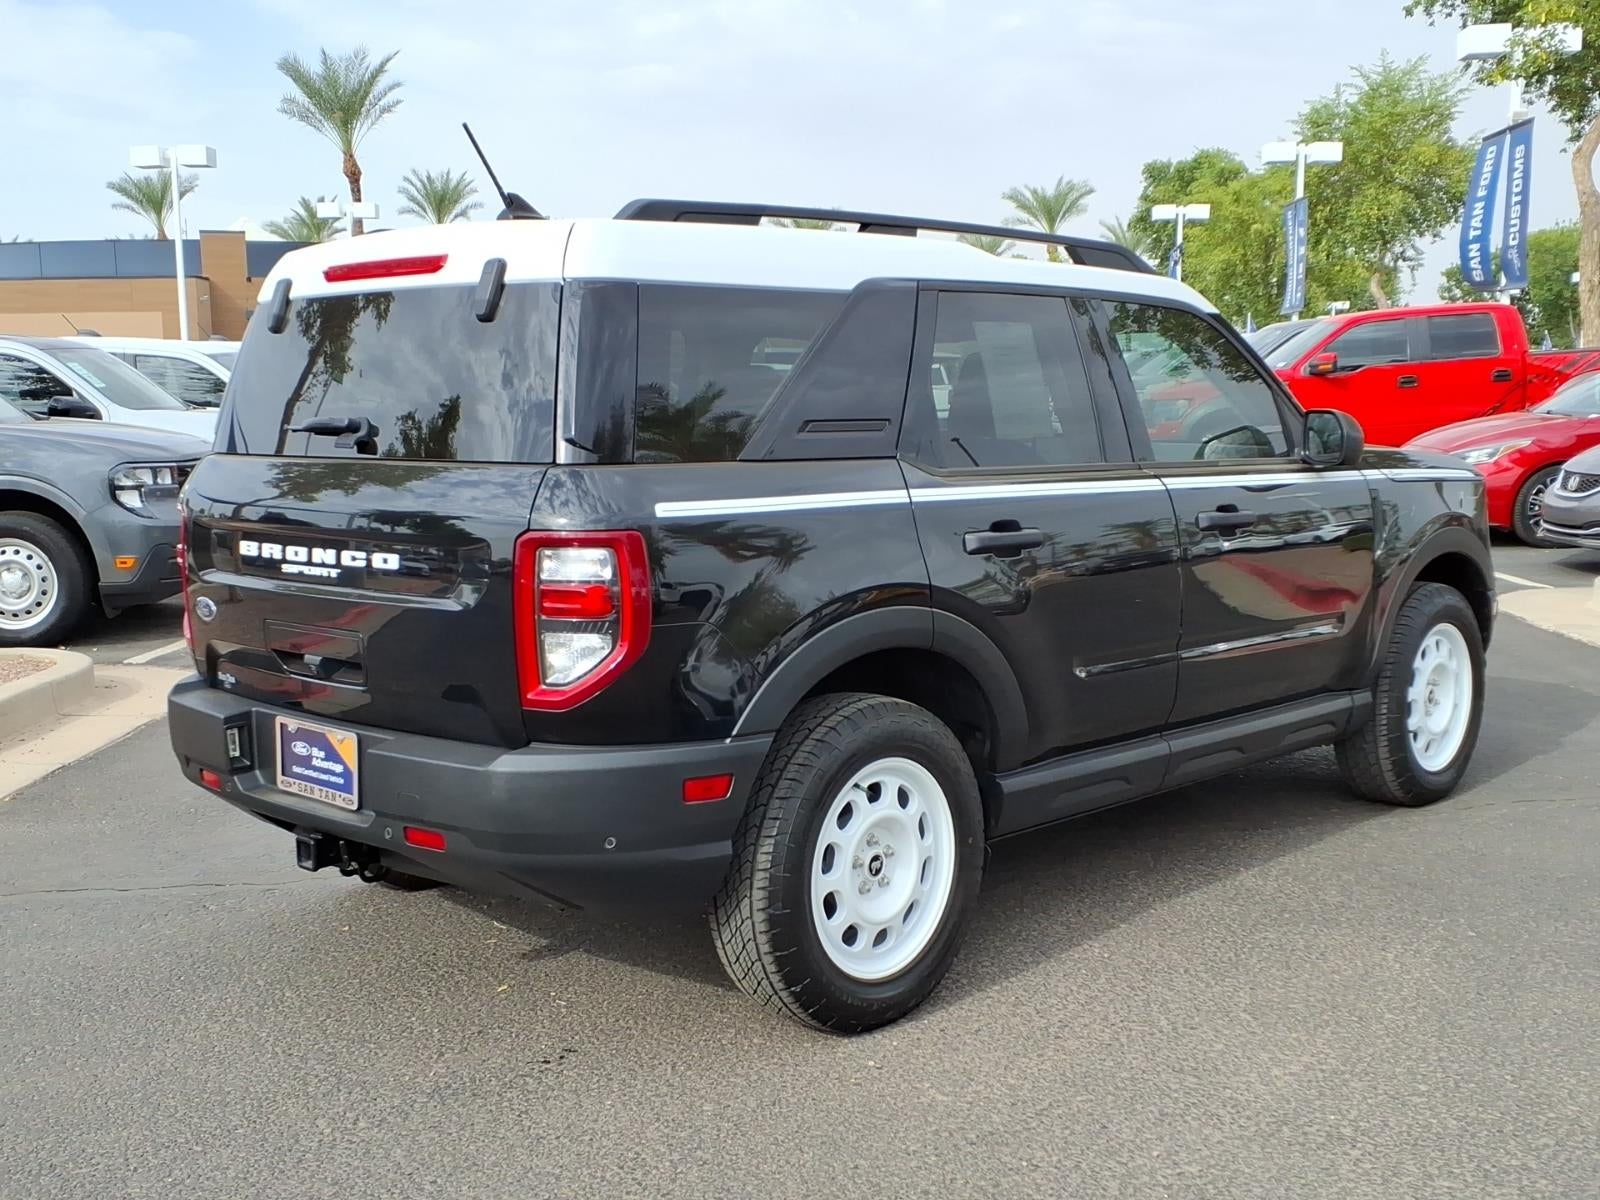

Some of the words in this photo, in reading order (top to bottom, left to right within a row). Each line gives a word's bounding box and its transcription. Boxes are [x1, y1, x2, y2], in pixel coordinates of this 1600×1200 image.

[1476, 145, 1497, 197] FORD
[1509, 144, 1525, 246] CUSTOMS
[1469, 201, 1485, 240] TAN
[1468, 243, 1484, 282] SAN
[239, 540, 400, 570] BRONCO
[280, 563, 342, 578] SPORT
[297, 782, 315, 796] SAN
[319, 789, 337, 802] TAN
